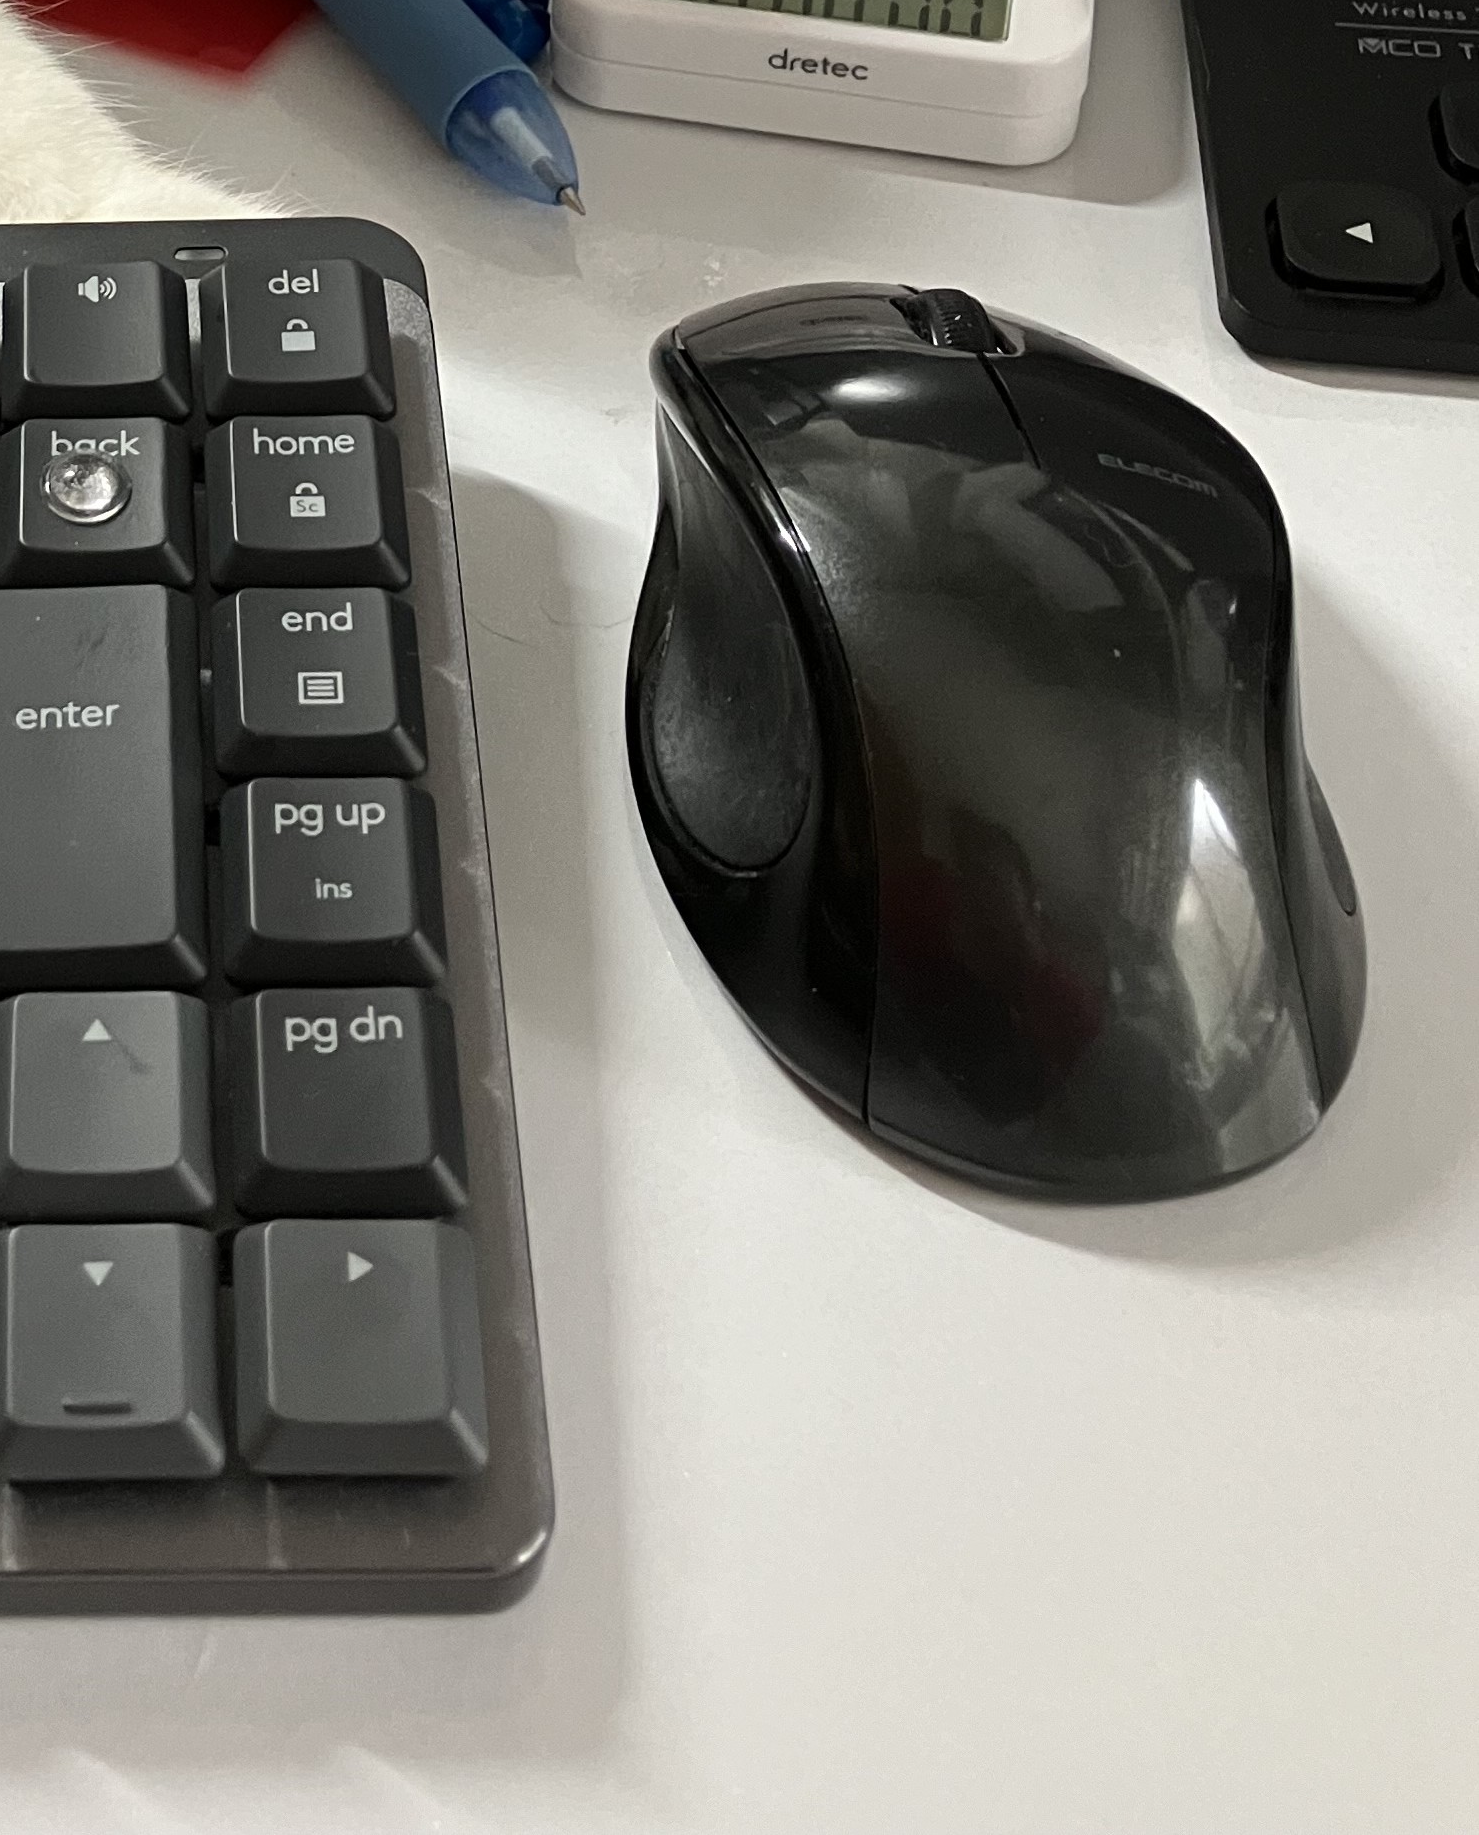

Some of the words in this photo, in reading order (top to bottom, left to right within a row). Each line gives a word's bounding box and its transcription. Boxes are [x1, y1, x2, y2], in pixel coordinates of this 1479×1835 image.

[1352, 1, 1467, 21] Wireless
[767, 47, 869, 81] dretec
[268, 268, 320, 295] del
[252, 427, 355, 456] home
[1098, 453, 1219, 499] ELECOM
[281, 601, 353, 632] end
[15, 701, 120, 730] enter
[274, 803, 324, 837] pg
[335, 802, 386, 835] up
[315, 878, 353, 899] ins
[284, 1017, 338, 1054] pg
[349, 1005, 403, 1042] dn
